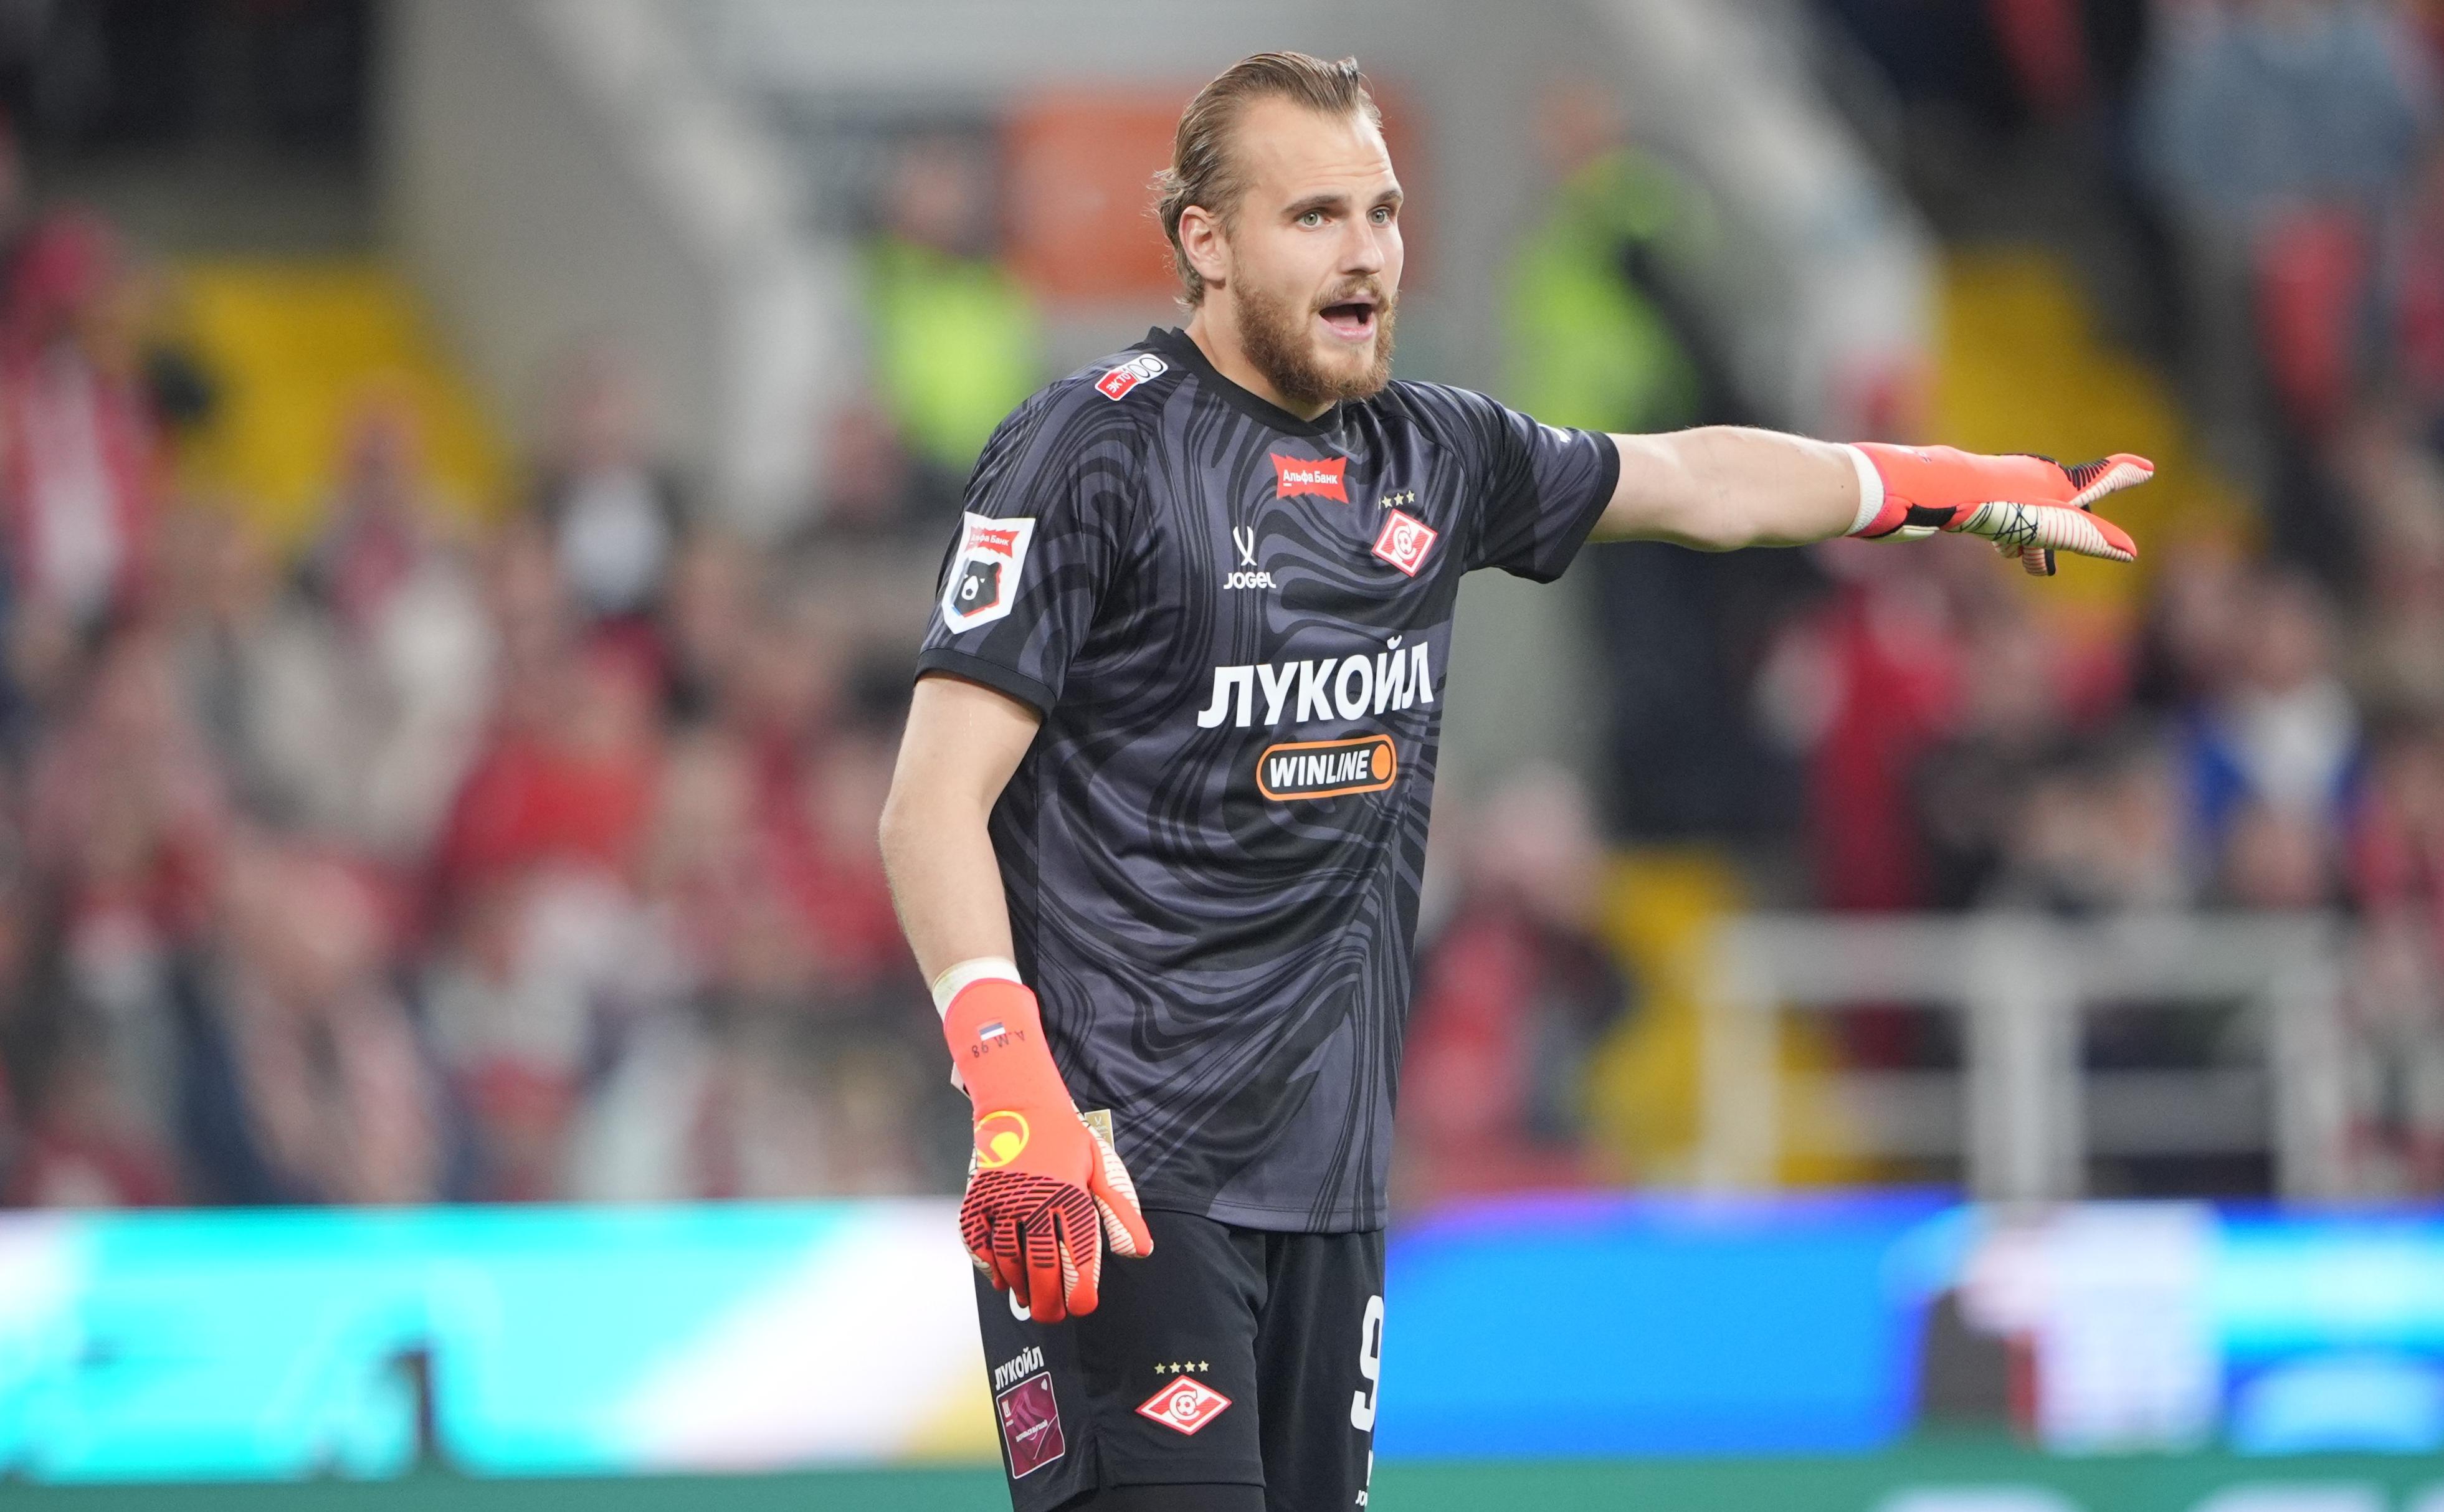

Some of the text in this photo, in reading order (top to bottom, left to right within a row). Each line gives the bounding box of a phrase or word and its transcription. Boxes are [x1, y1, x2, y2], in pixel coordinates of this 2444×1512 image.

[1283, 468, 1338, 486] Альфа Банк
[989, 535, 1010, 546] Банк
[1223, 571, 1277, 589] JOGEL
[1197, 634, 1434, 728] ЛУКОЙЛ
[1270, 749, 1371, 788] WINLINE
[994, 1346, 1045, 1391] ЛУКОЙЛ
[1350, 1295, 1384, 1432] 9
